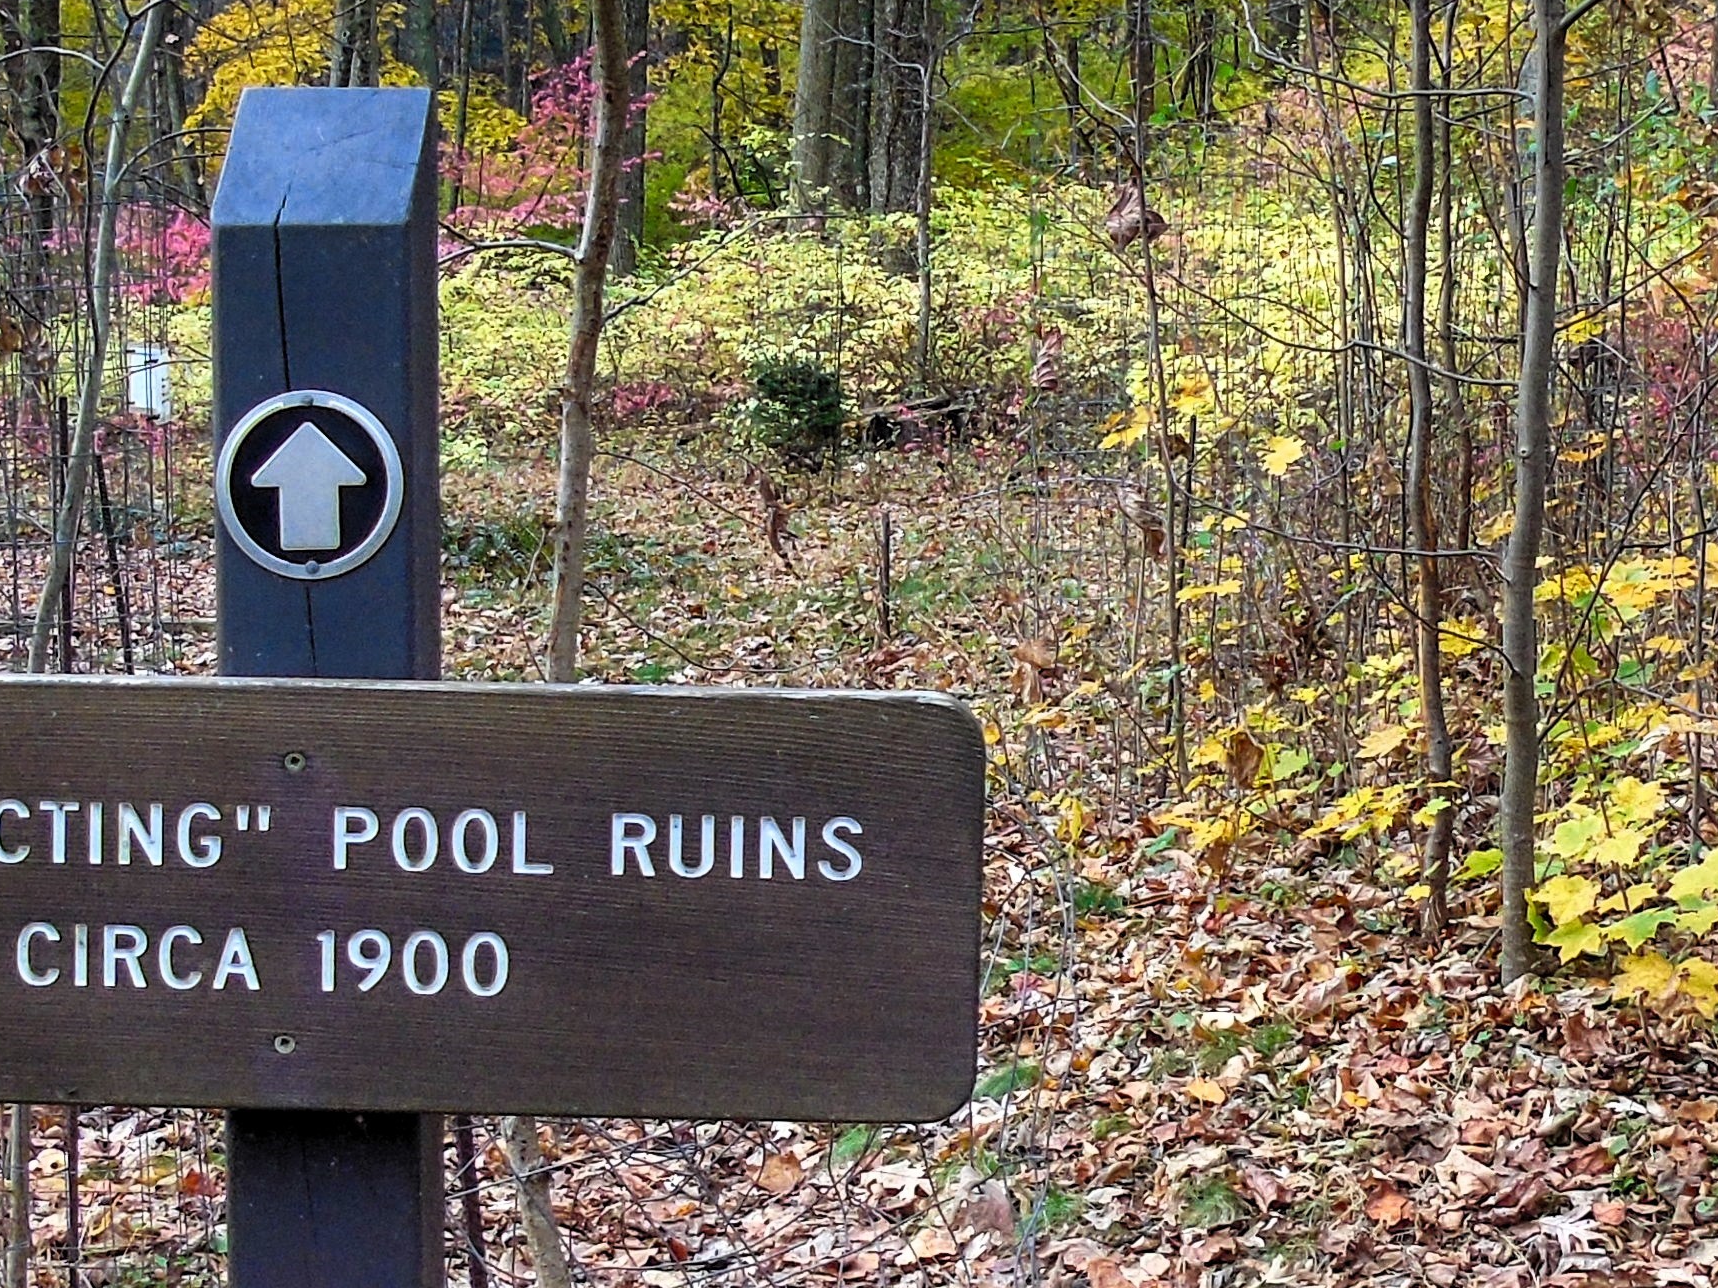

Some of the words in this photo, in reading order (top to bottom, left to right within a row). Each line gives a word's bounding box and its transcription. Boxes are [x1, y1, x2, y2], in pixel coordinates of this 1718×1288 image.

[332, 806, 555, 876] POOL
[611, 812, 864, 882] RUINS
[16, 921, 261, 991] CIRCA
[315, 928, 510, 998] 1900
